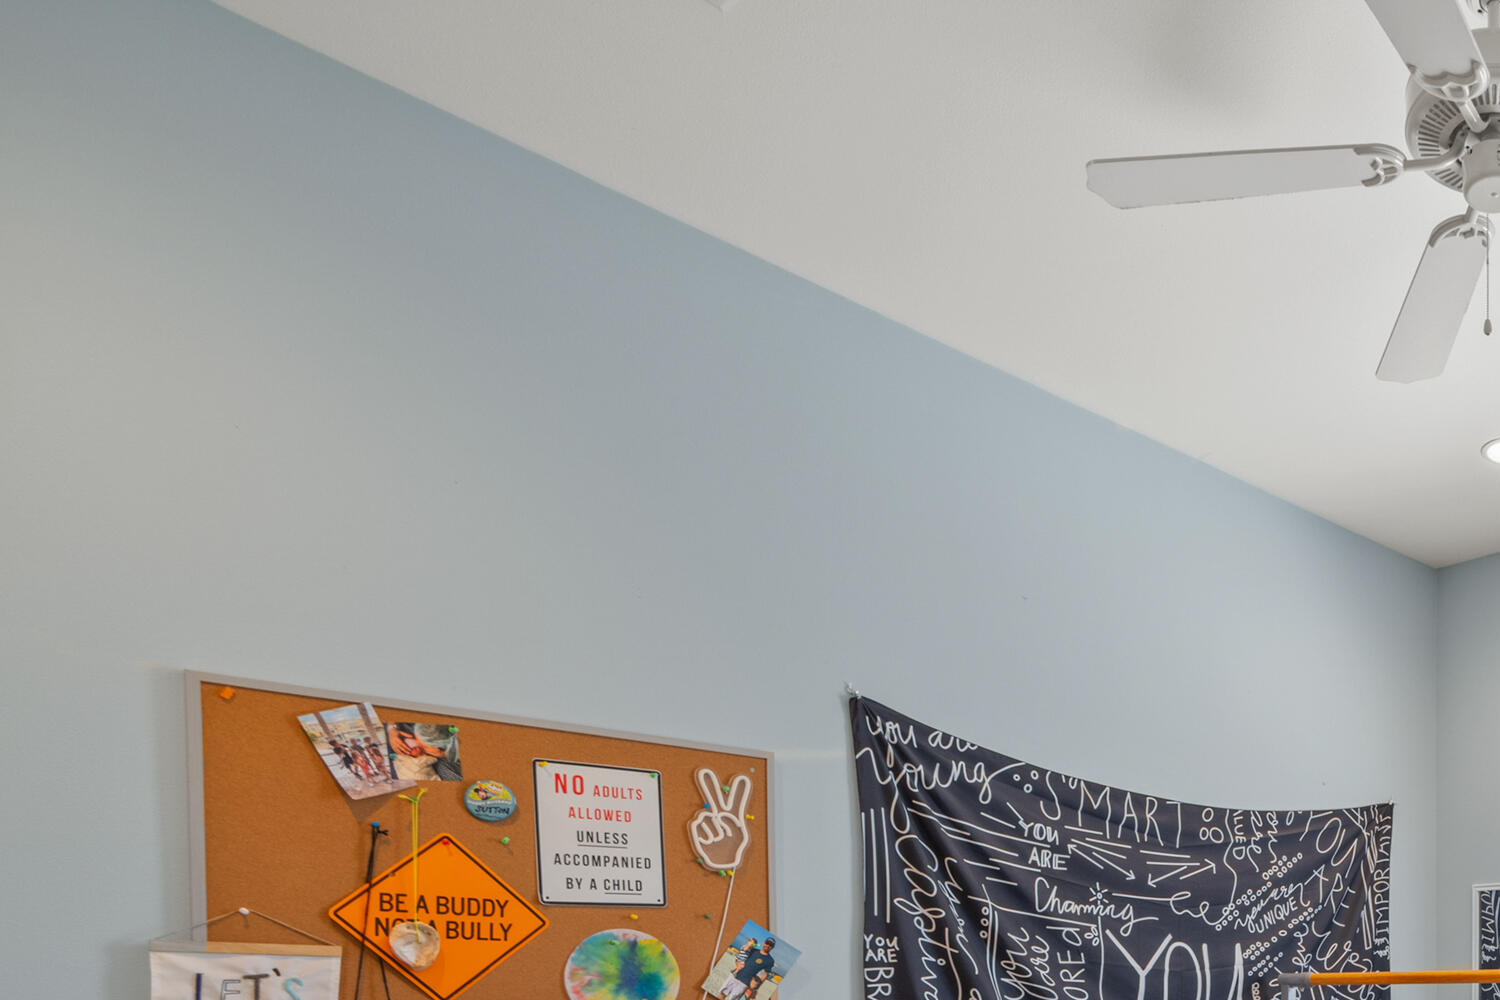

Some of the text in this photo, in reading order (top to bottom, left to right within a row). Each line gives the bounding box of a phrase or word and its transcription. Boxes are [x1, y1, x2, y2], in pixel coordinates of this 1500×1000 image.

[554, 773, 643, 801] NO ADULTS
[568, 806, 632, 823] ALLOWED
[1040, 770, 1182, 848] SMART
[576, 830, 628, 846] UNLESS
[1018, 817, 1060, 846] YOU
[554, 853, 651, 869] ACCOMPANIED
[1028, 847, 1071, 870] ARE
[566, 877, 643, 892] BY A CHILD
[379, 893, 509, 918] BE A BUDDY
[1255, 896, 1298, 934] UNIQUE
[446, 921, 512, 942] BULLY
[863, 934, 899, 950] YOU
[864, 950, 898, 963] ARE
